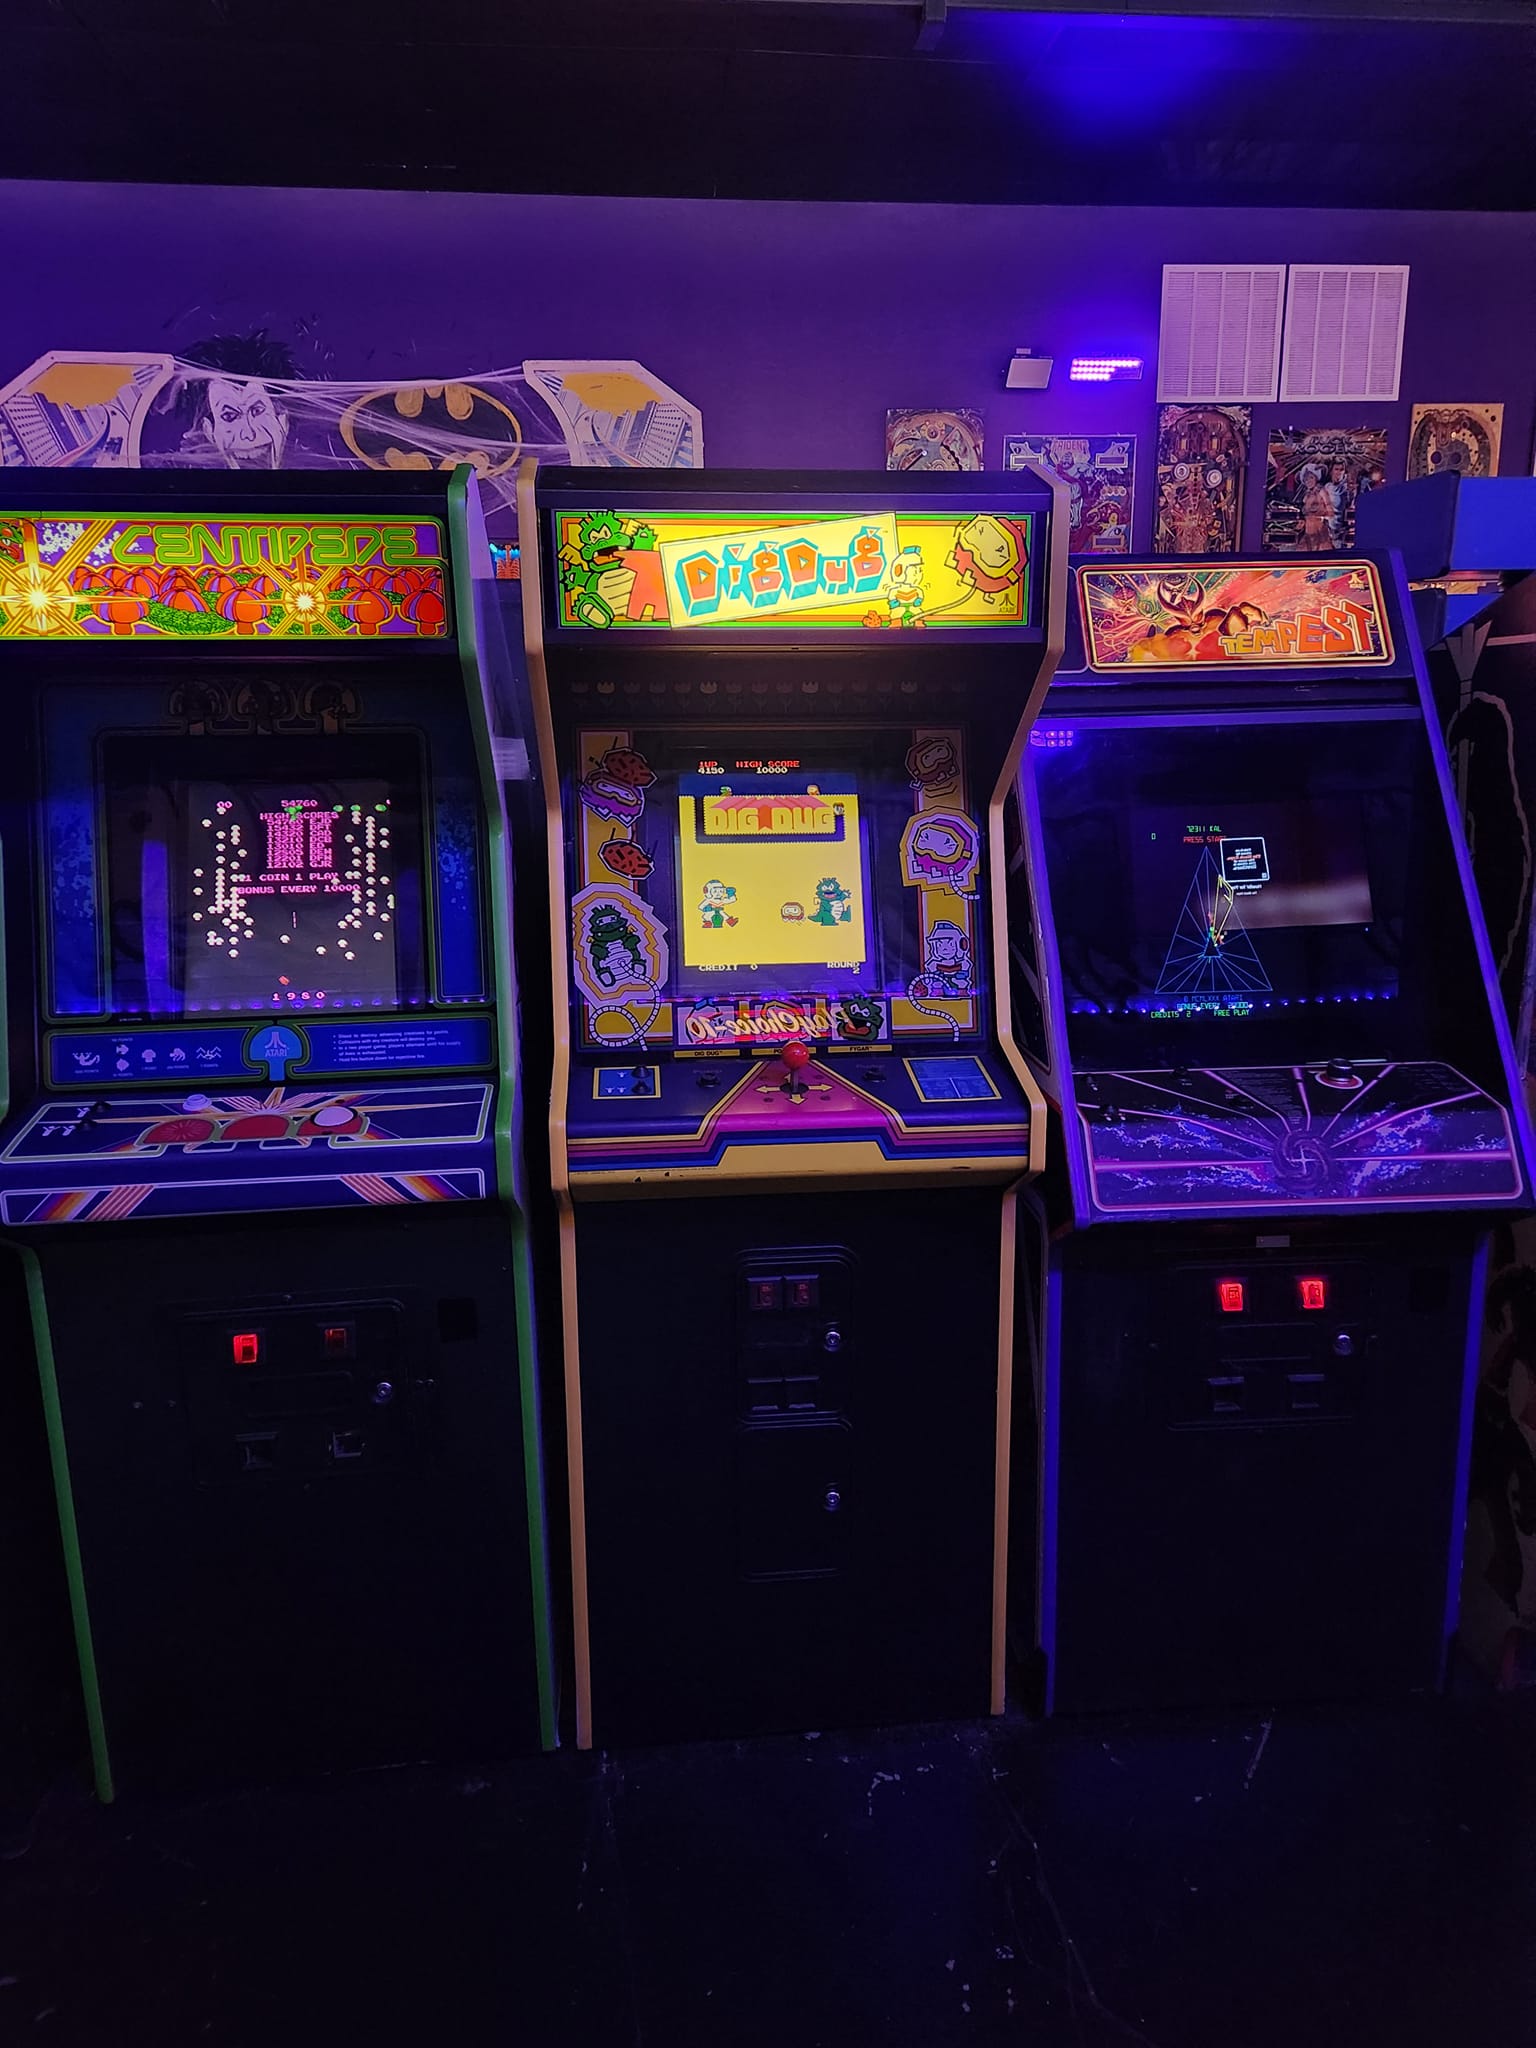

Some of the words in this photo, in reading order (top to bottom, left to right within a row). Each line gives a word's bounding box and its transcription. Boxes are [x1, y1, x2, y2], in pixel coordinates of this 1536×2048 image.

[1295, 443, 1366, 455] ROGERS
[112, 525, 420, 566] CENTIPEDE
[1219, 599, 1375, 656] TEMPEST
[768, 760, 800, 768] SCORE
[259, 812, 290, 820] HIGH
[295, 811, 339, 819] SCORES
[709, 806, 758, 832] DIG
[771, 806, 833, 832] DUG
[259, 873, 290, 882] COIN
[309, 872, 339, 881] PLAY
[237, 886, 275, 895] BONUS
[281, 885, 317, 894] EVERY
[698, 964, 738, 972] CREDIT
[827, 961, 860, 969] ROUND
[1150, 1010, 1180, 1018] CREDITS
[1213, 1009, 1231, 1017] FREE
[1234, 1008, 1250, 1016] PLAY
